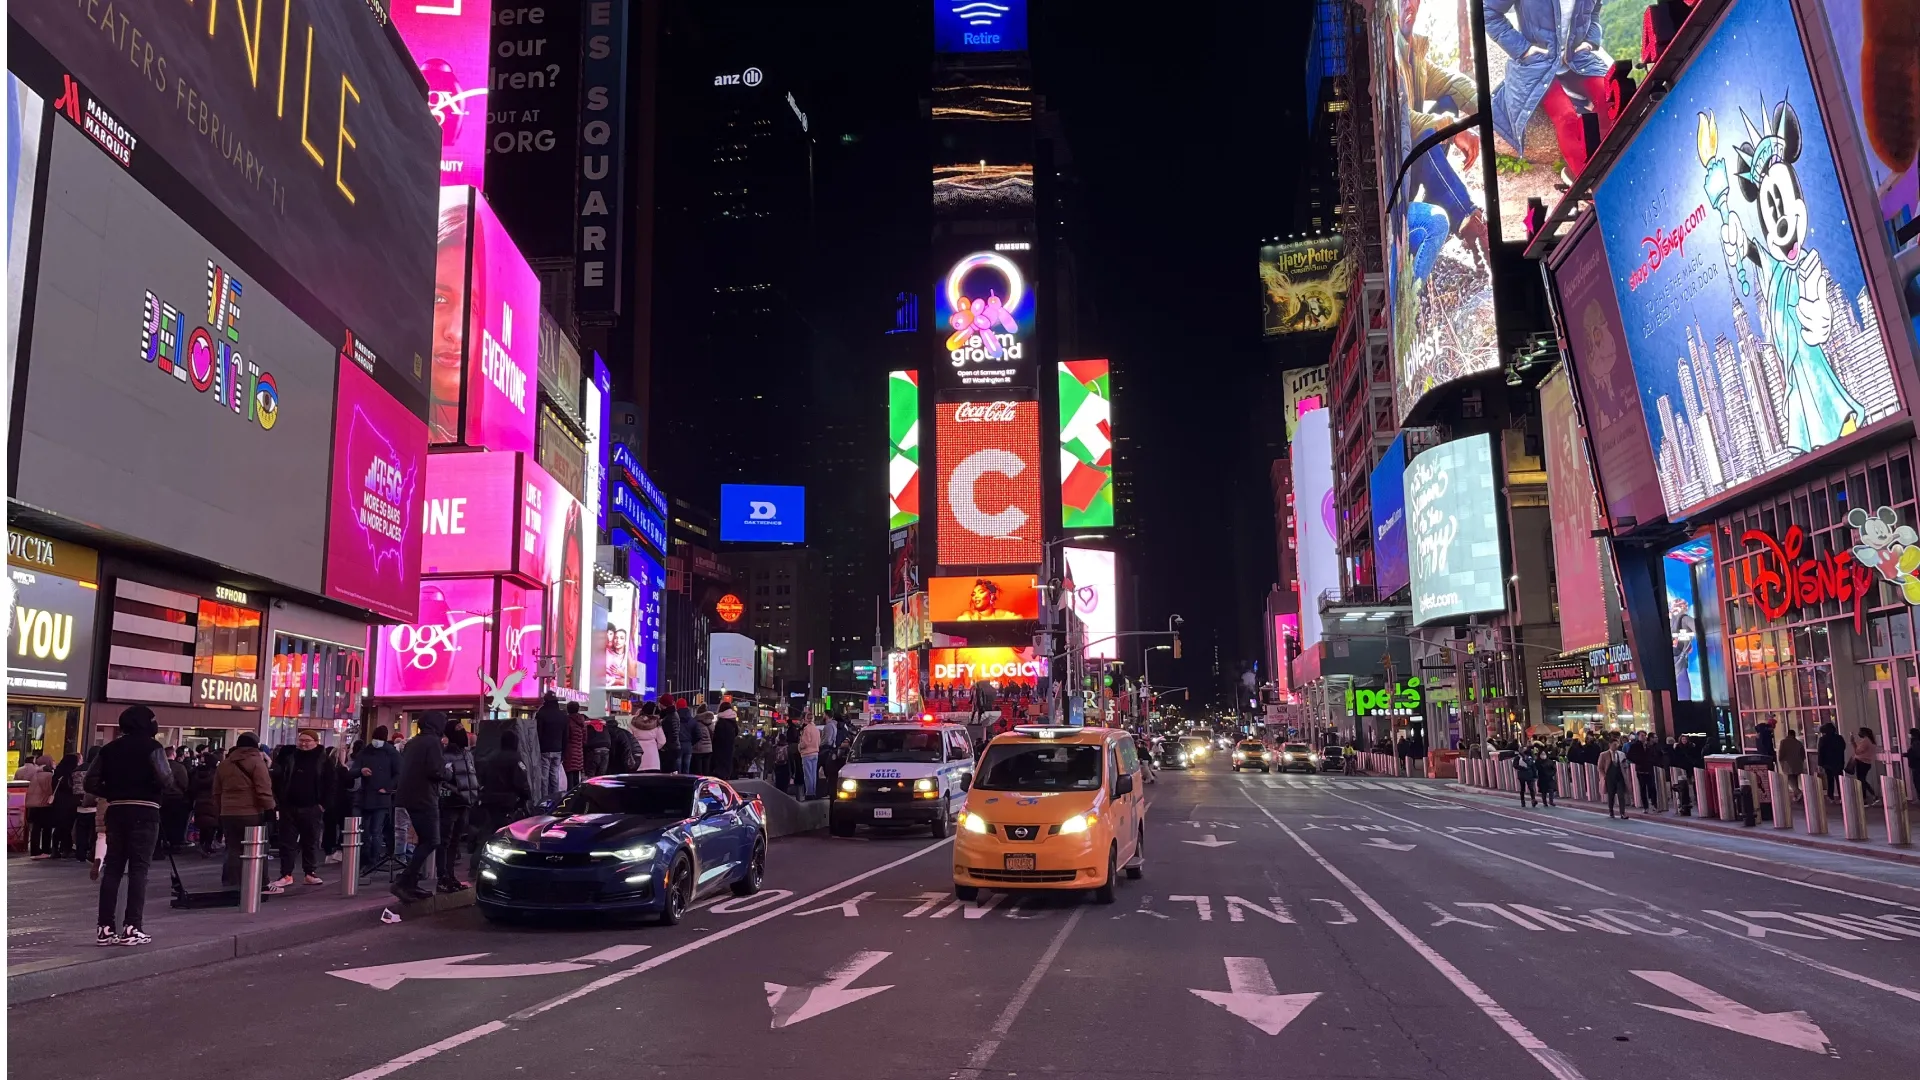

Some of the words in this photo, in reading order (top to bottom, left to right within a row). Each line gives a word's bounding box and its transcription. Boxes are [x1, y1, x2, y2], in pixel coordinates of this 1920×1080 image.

[497, 39, 547, 58] our
[963, 31, 1001, 46] Retire
[78, 0, 167, 92] EATERS
[176, 77, 265, 190] FEBRUARY
[87, 97, 138, 150] MARRIOTT
[521, 110, 540, 123] AT
[85, 117, 131, 164] MARQUIS
[486, 129, 557, 154] .ORG
[583, 86, 612, 287] SQUARE
[1641, 188, 1669, 228] VISIT
[995, 242, 1032, 251] SAMSUNG
[1279, 252, 1308, 273] Harry
[1307, 247, 1339, 268] Potter
[1294, 237, 1333, 248] BROADWAY
[1670, 273, 1681, 294] THE
[1682, 253, 1705, 281] MAGIC
[1680, 281, 1698, 303] YOUR
[1697, 263, 1719, 289] DOOR
[207, 257, 243, 343] WE
[502, 301, 512, 350] IN
[140, 289, 243, 415] BELONG
[482, 329, 527, 415] EVERYONE
[247, 360, 279, 430] TO
[954, 401, 1018, 423] Coca-Cola
[360, 507, 367, 525] IN
[367, 510, 382, 533] MORE
[382, 520, 402, 543] PLACES
[364, 490, 380, 513] MORE
[379, 500, 387, 518] 5G
[387, 504, 401, 525] BARS
[215, 586, 248, 605] SEPHORA
[16, 605, 74, 662] YOU
[934, 663, 977, 679] DEFY
[981, 661, 1037, 678] LOGIC
[1542, 667, 1581, 680] ELECTRONICS
[1589, 649, 1606, 667] GIFTS
[201, 678, 258, 703] SEPHORA
[1562, 678, 1583, 686] LUGGAGE
